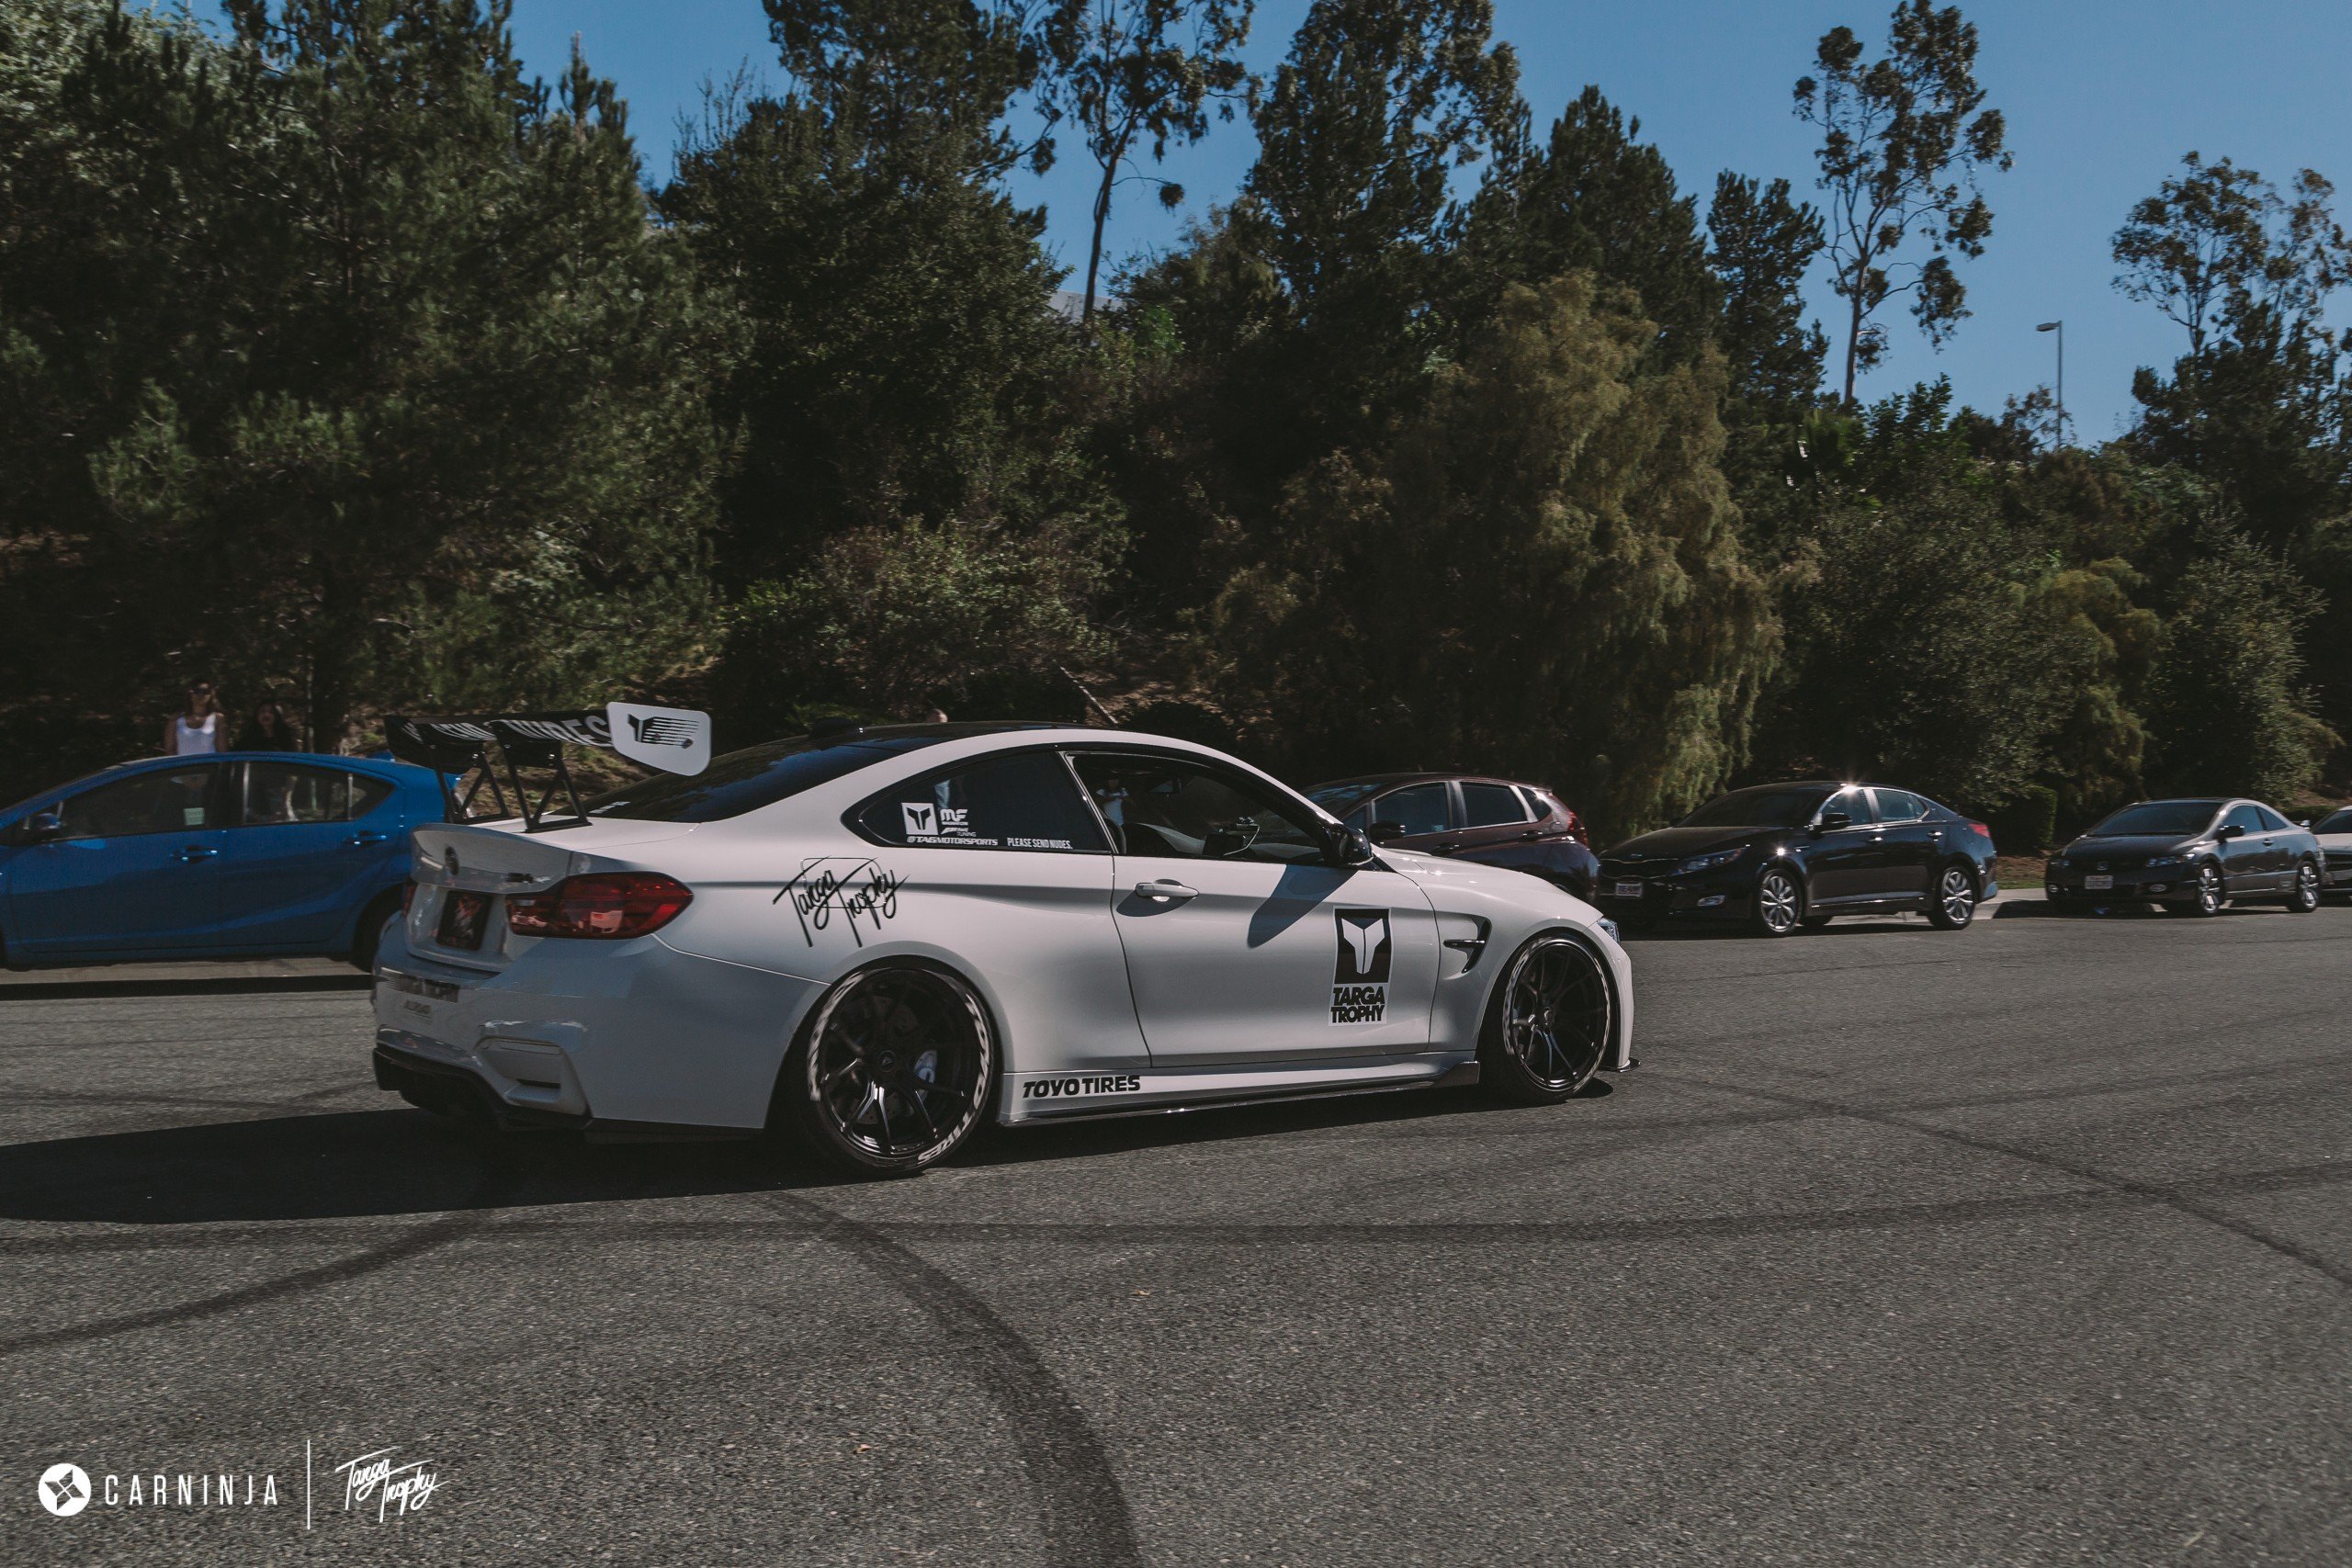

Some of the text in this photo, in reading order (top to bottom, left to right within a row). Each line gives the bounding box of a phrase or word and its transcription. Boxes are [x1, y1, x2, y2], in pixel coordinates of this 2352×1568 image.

[1007, 838, 1032, 847] PLEASE
[1032, 839, 1050, 848] SEND
[1333, 986, 1385, 1007] TARGA
[1330, 1005, 1385, 1024] TROPHY
[1023, 1076, 1141, 1099] TOYO TIRES
